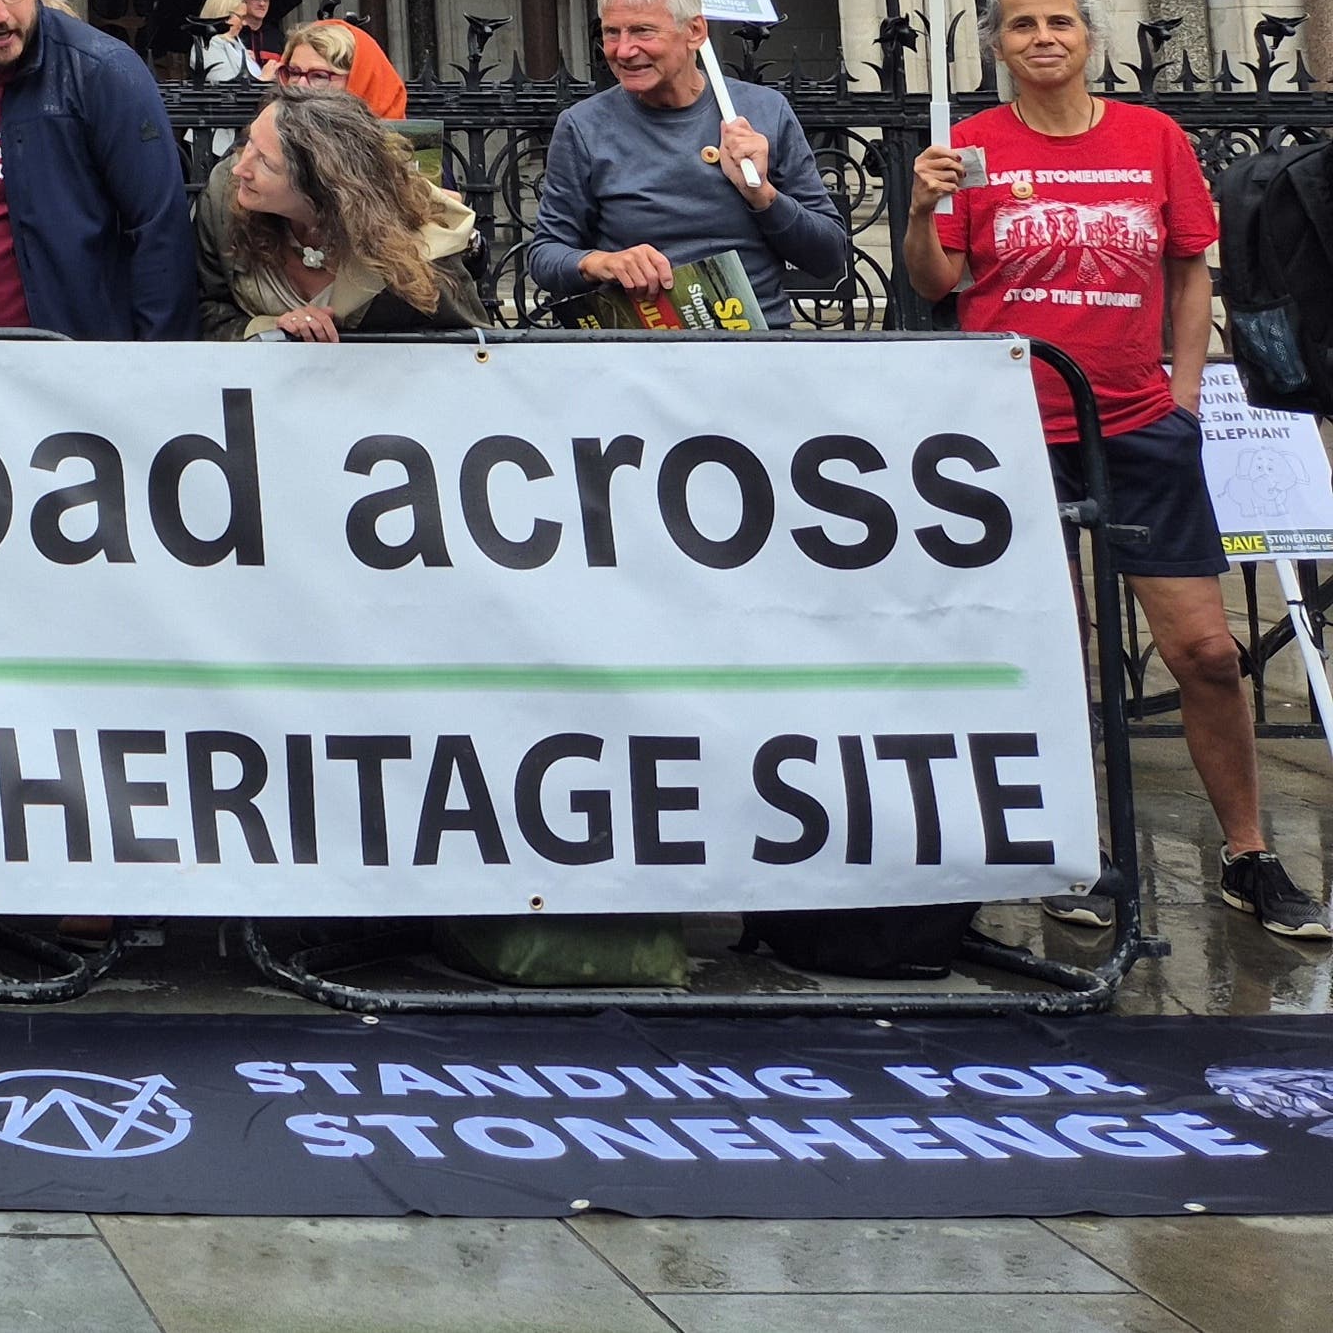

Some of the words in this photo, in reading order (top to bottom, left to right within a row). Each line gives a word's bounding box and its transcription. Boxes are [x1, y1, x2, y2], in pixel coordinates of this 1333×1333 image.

[990, 170, 1033, 185] SAVE
[1036, 170, 1152, 184] STONEHENGE
[1003, 288, 1047, 303] STOP
[1050, 289, 1082, 305] THE
[1085, 291, 1142, 307] TUNNEL
[1199, 411, 1243, 423] 2.5bn
[1248, 409, 1300, 421] WHITE
[1205, 428, 1291, 441] ELEPHANT
[344, 433, 1012, 571] across
[1222, 535, 1266, 552] SAVE
[1267, 534, 1333, 545] STONEHENGE
[752, 733, 1054, 866] SITE
[235, 1060, 853, 1099] STANDING
[883, 1063, 1147, 1099] FOR
[285, 1111, 1269, 1161] STONEHENGE
